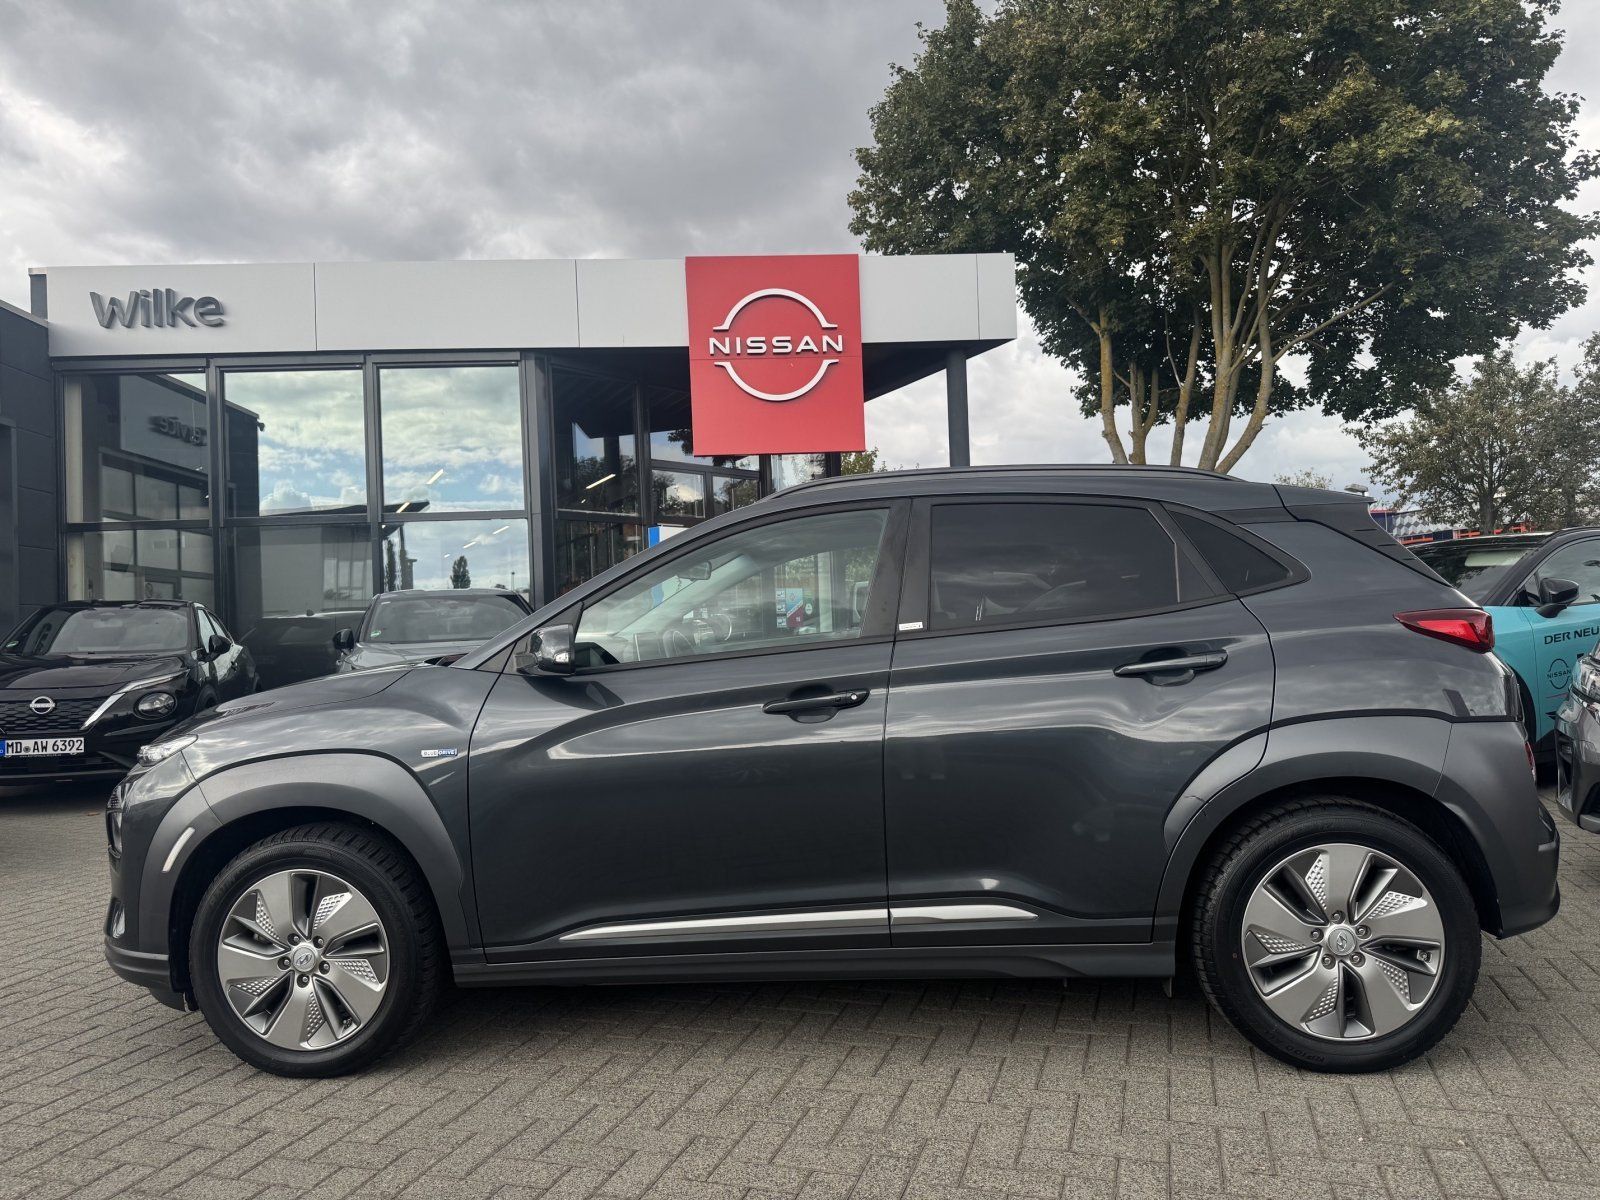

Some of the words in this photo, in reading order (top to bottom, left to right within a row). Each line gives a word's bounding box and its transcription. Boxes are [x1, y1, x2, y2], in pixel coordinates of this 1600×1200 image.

[89, 288, 225, 329] Wilke
[708, 334, 843, 355] NISSAN
[1544, 631, 1571, 645] DER
[1573, 626, 1600, 639] NEU
[1546, 669, 1571, 679] NISSAN
[6, 741, 23, 754] MD
[33, 740, 48, 753] AW
[52, 739, 83, 752] 6392
